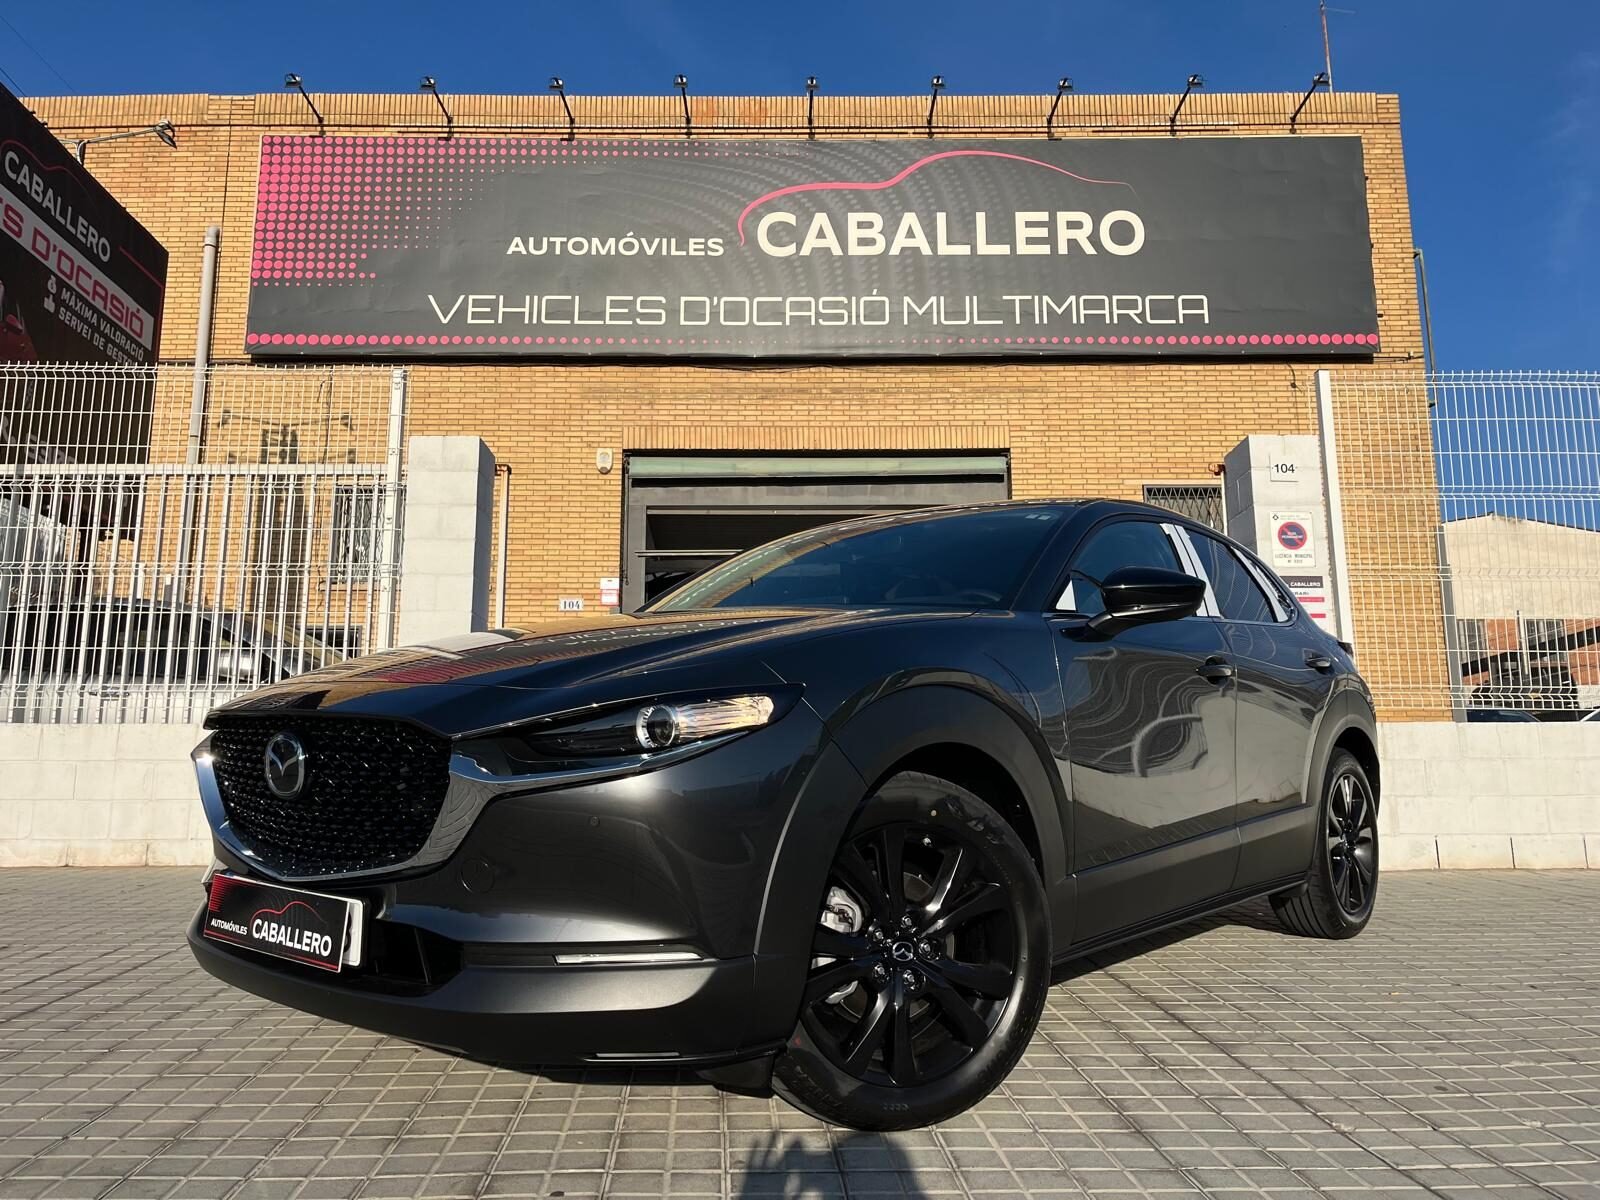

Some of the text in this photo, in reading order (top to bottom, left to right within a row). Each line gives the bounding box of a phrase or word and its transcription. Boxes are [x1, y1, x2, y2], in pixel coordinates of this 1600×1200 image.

[4, 150, 111, 262] CABALLERO
[506, 231, 725, 256] AUTOMÓVILES
[756, 209, 1146, 258] CABALLERO
[0, 197, 144, 339] S D'OCASIÓ
[58, 306, 92, 341] SERVEI
[93, 331, 106, 350] DE
[60, 287, 145, 362] MÀXIMA VALORACIÓ
[427, 288, 1210, 326] VEHICLES D'OCASIÓ MULTIMARCA
[1274, 463, 1296, 474] 104
[563, 600, 580, 610] 104
[210, 917, 332, 957] AUTOMÓVILES CABALLERO
